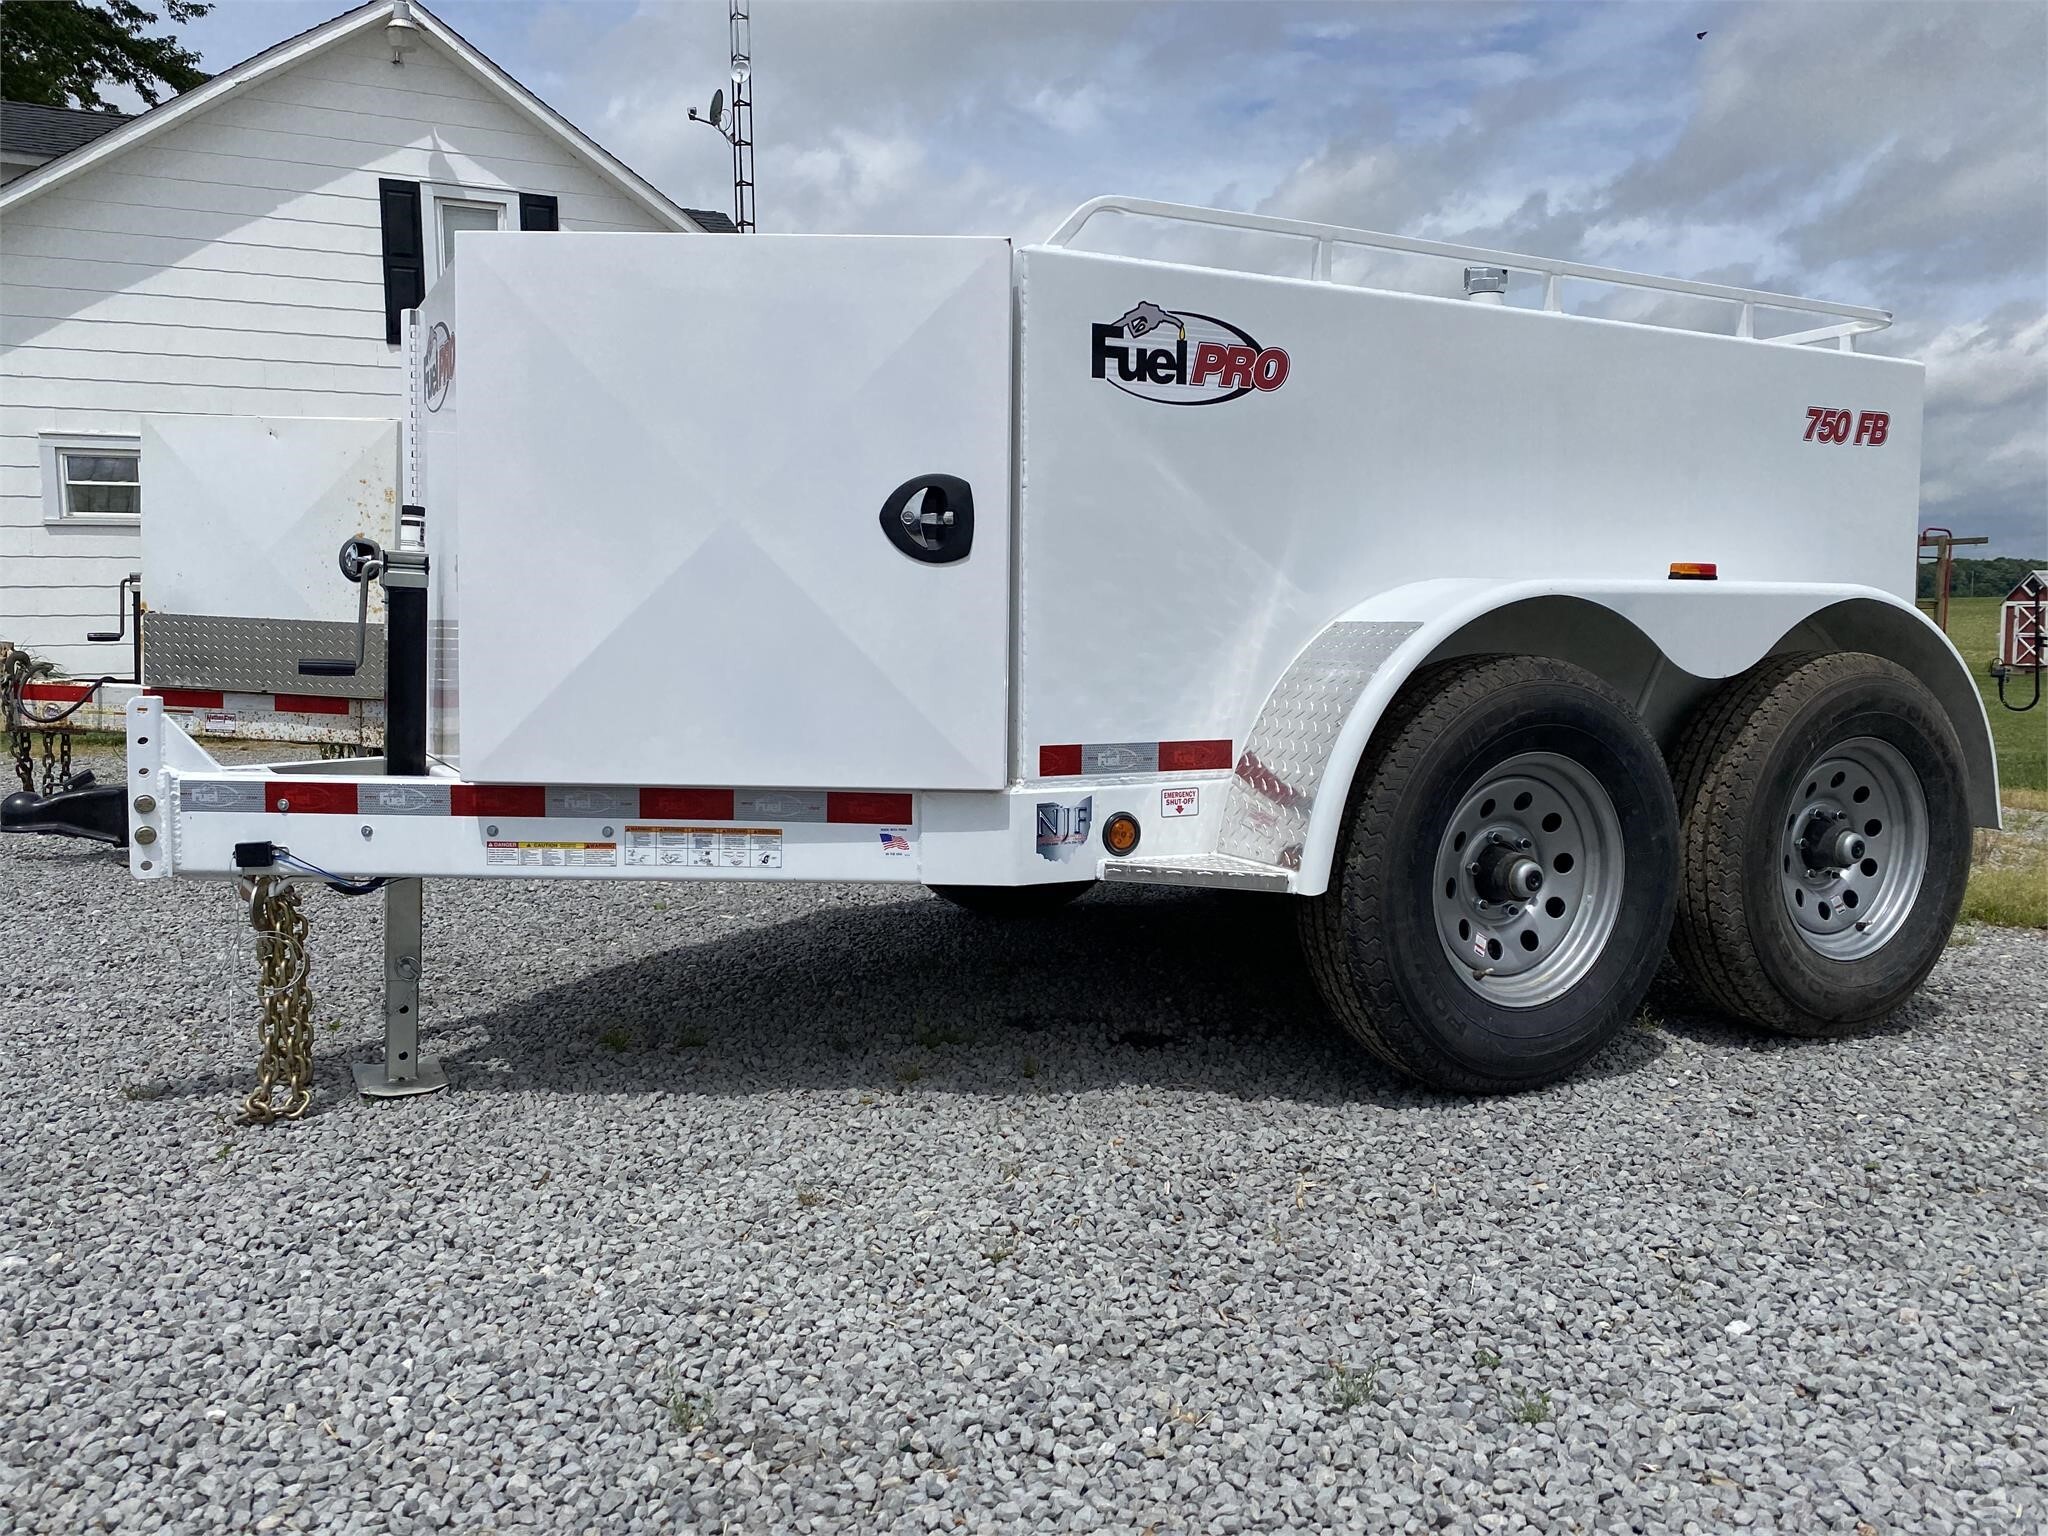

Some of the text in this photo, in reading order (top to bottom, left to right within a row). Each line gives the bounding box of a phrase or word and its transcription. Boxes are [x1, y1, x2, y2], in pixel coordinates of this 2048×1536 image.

[1803, 406, 1890, 447] 750 FB
[1163, 790, 1197, 799] EMERGENCY
[1166, 798, 1195, 806] SHUT-OFF
[1037, 807, 1088, 842] NJF
